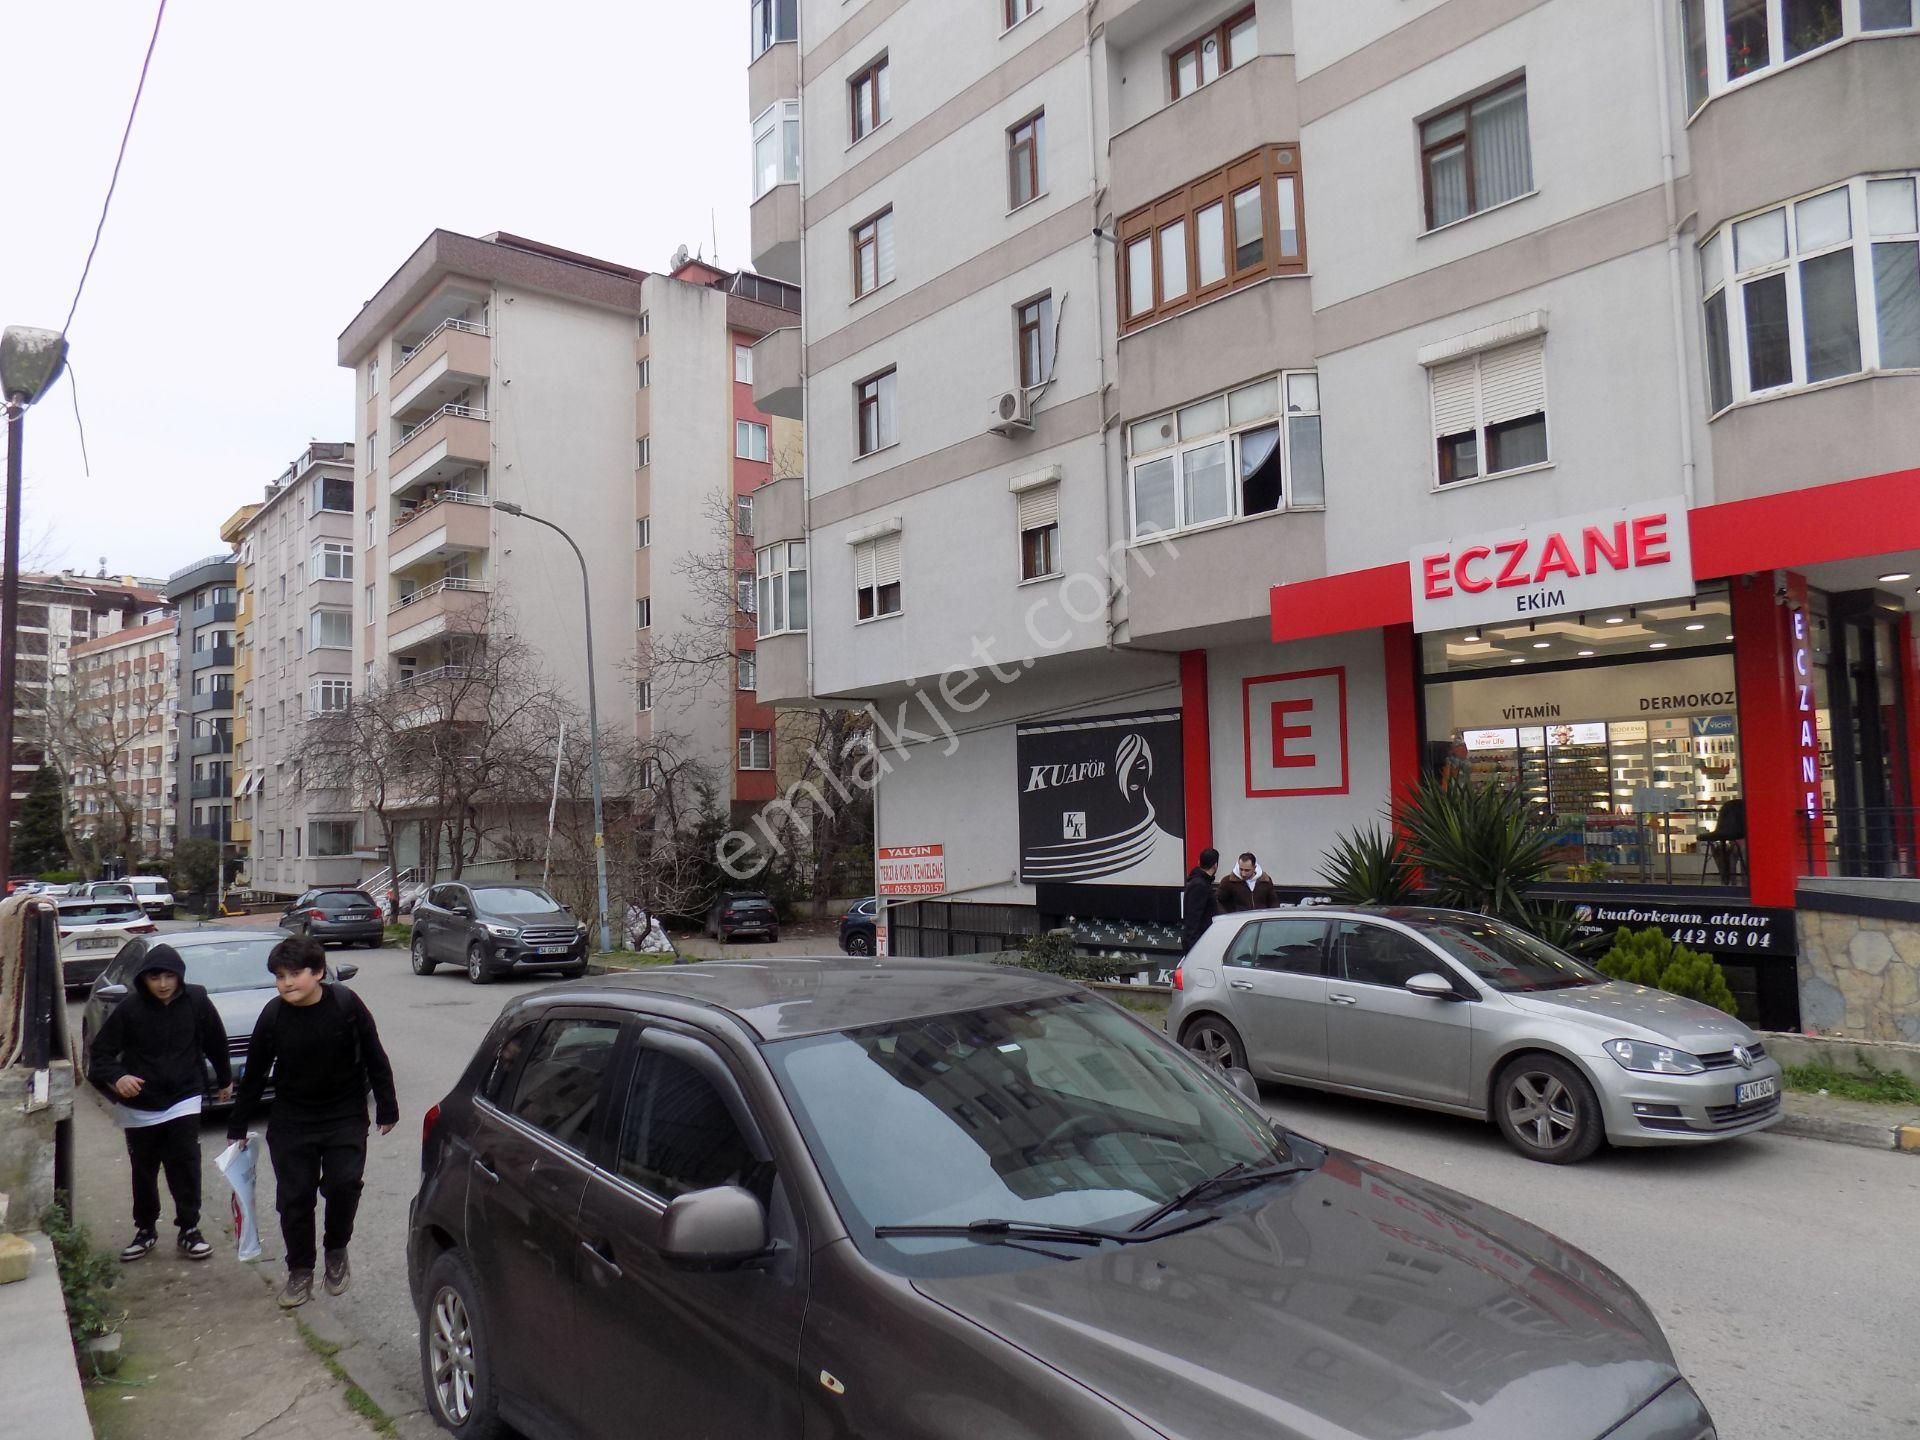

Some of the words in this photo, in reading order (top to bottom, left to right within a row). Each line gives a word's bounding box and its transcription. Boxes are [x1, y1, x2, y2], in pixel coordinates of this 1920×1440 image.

[1423, 513, 1671, 600] ECZANE
[1516, 588, 1565, 612] EKİM
[1502, 702, 1560, 719] VİTAMİN
[1794, 613, 1815, 819] ECZANE
[1271, 699, 1316, 768] E
[1475, 737, 1491, 746] New
[1023, 759, 1105, 792] KUAFÖR
[888, 846, 930, 857] YALÇIN
[1597, 907, 1770, 927] kuaforkenan_atalar
[1671, 928, 1706, 944] 442
[1713, 930, 1738, 946] 86
[1746, 931, 1771, 948] 04
[1740, 1086, 1749, 1100] 34
[1750, 1083, 1759, 1098] NT
